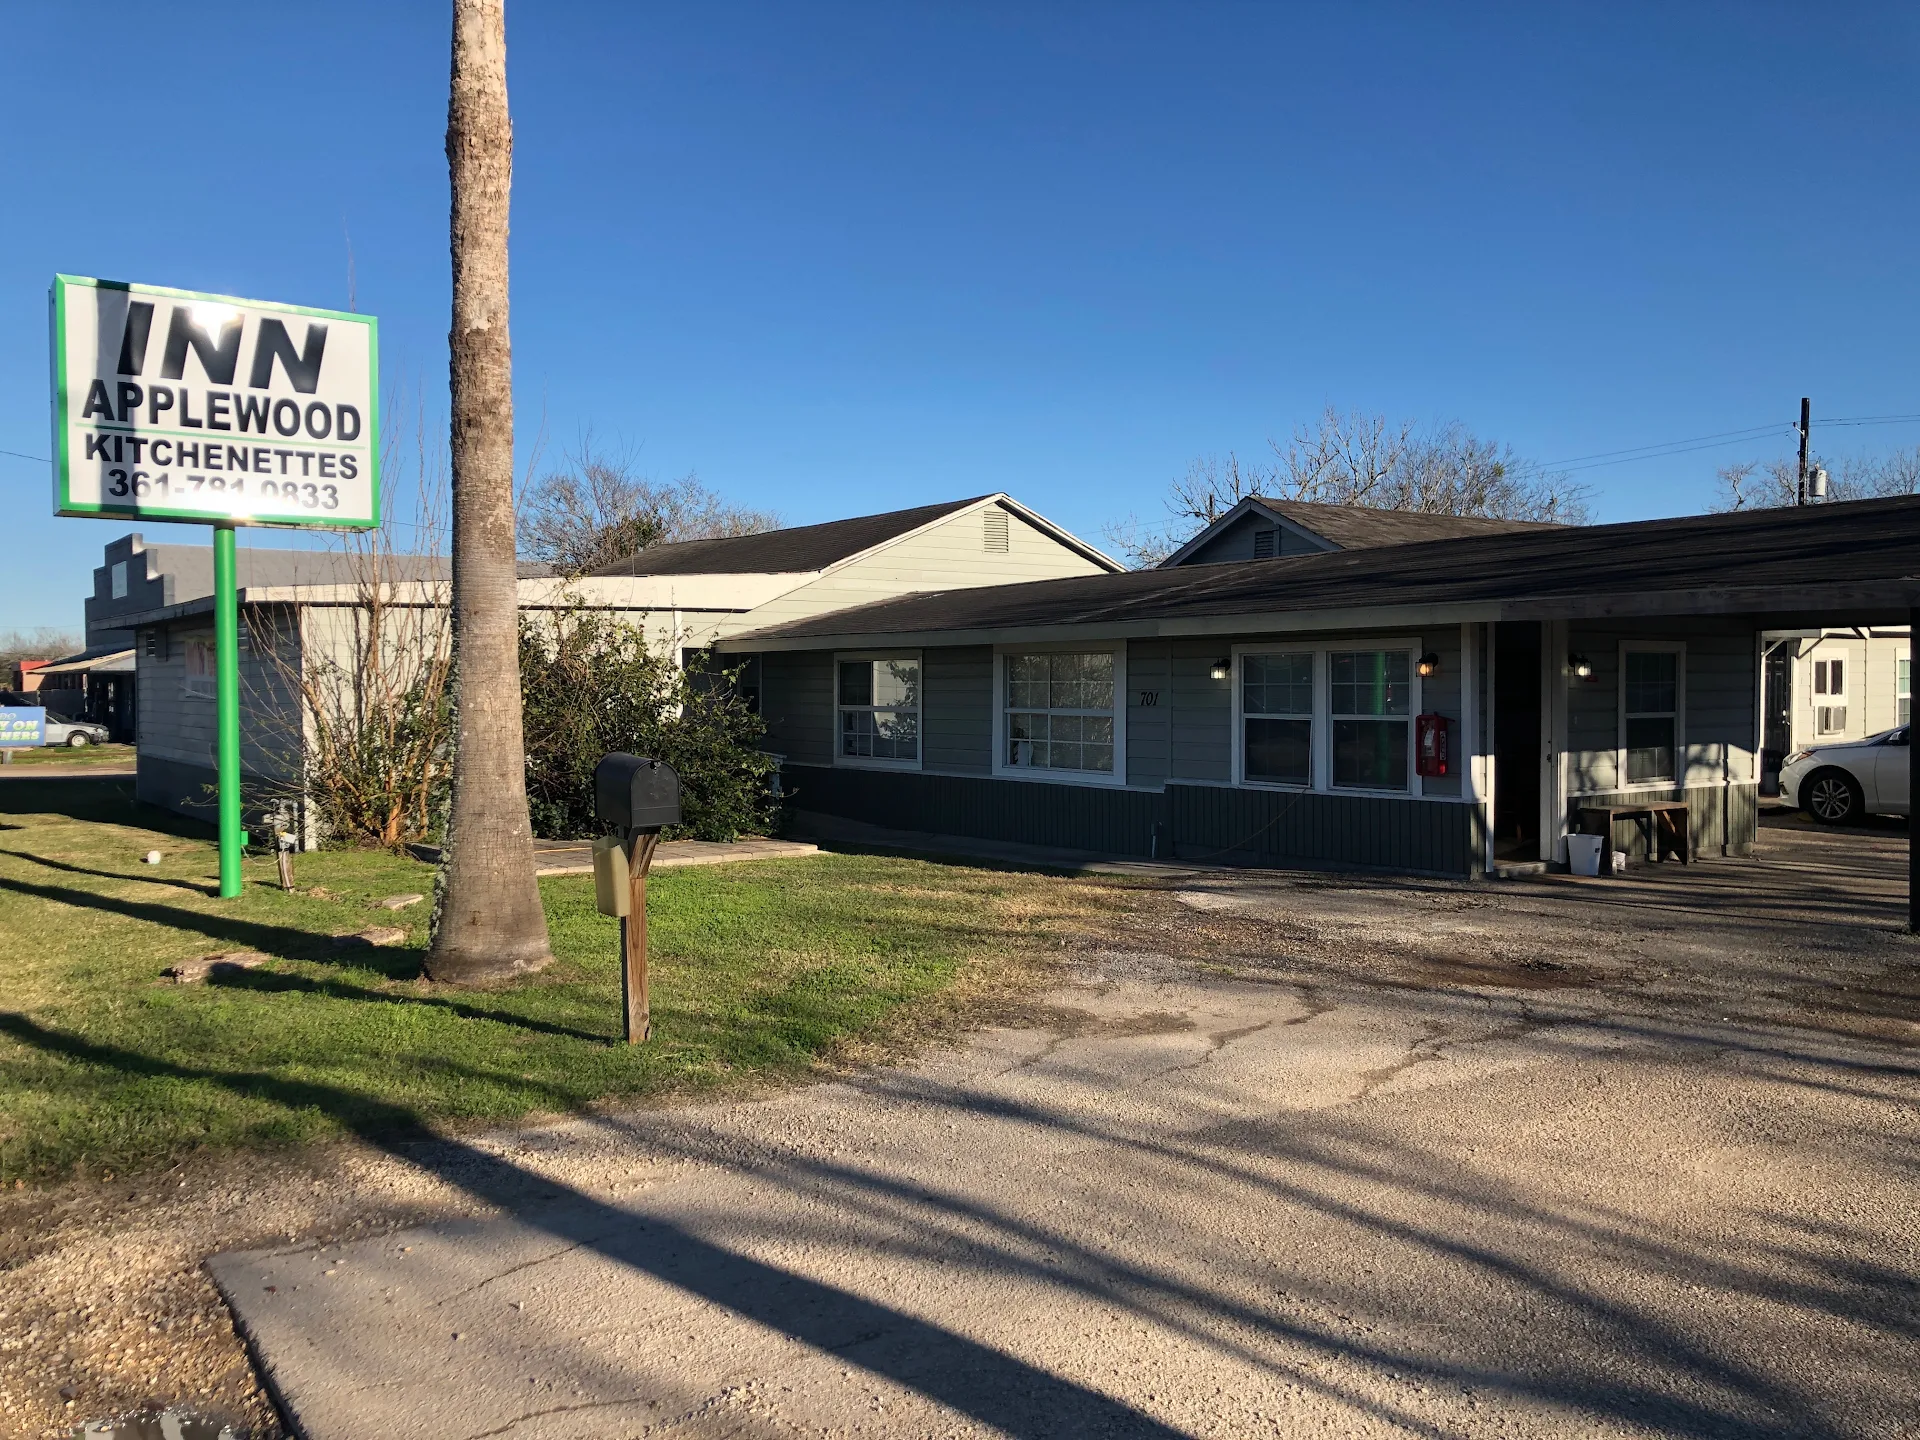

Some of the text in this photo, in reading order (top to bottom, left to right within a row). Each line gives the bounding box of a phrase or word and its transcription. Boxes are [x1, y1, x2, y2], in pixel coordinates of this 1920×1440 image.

[116, 300, 329, 395] INN
[82, 378, 361, 442] APPLEWOOD
[85, 432, 358, 480] KITCHENETTES
[108, 468, 340, 510] 361-7810833
[1140, 691, 1159, 706] 701
[12, 720, 39, 731] ON
